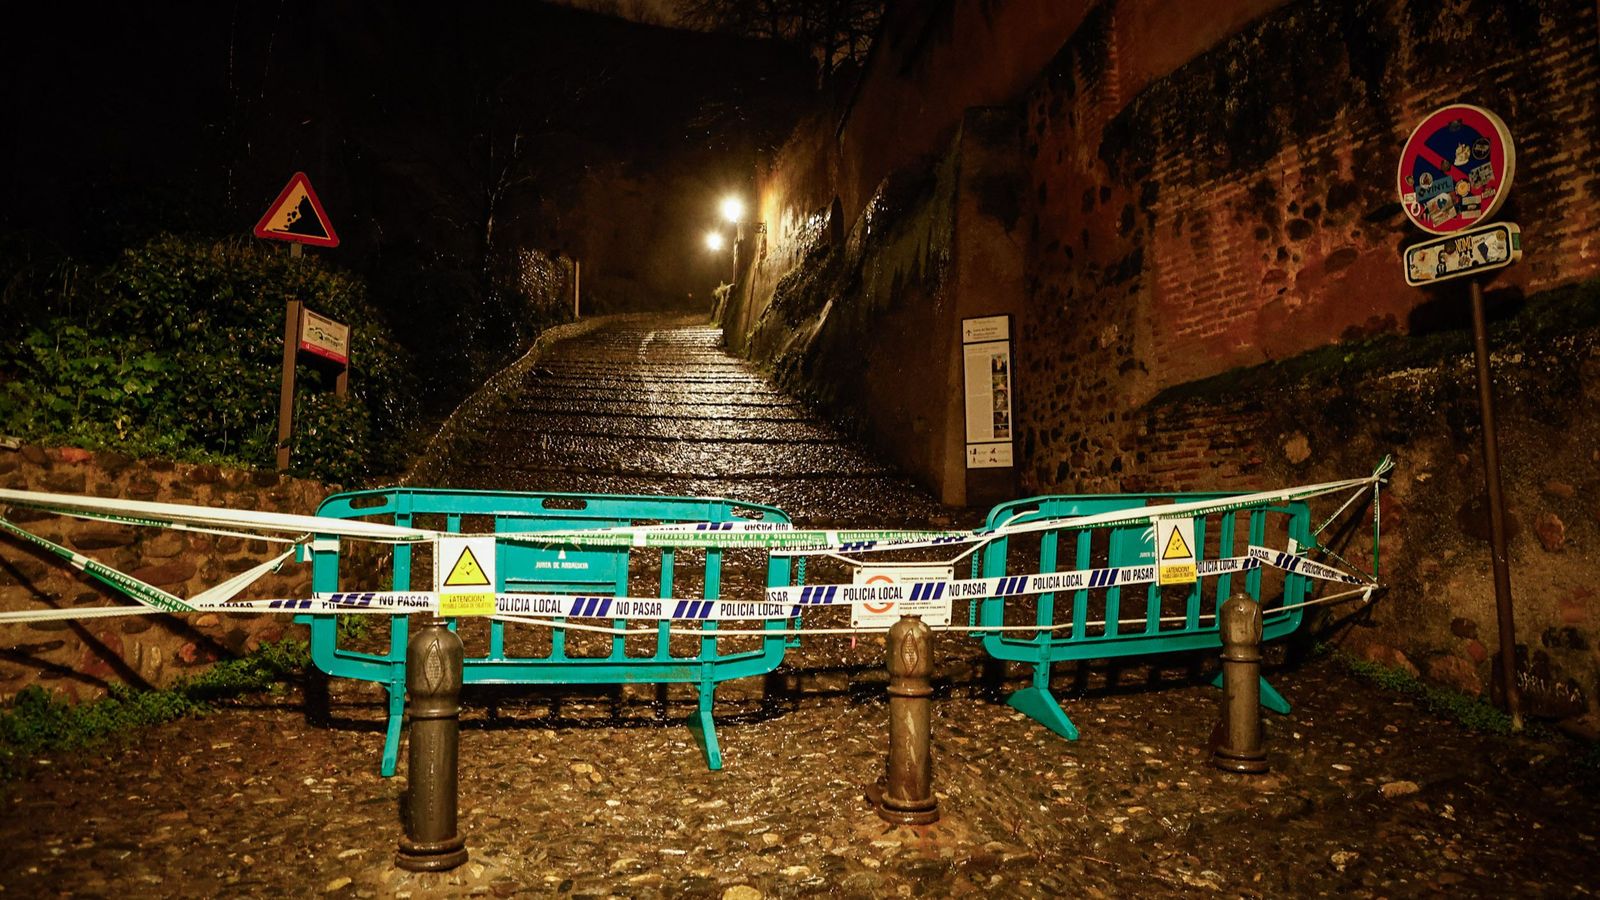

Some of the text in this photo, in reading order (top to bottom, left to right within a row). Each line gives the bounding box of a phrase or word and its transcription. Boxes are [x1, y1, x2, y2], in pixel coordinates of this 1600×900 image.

[1033, 574, 1083, 590] POLICIA LOCAL
[1121, 570, 1131, 582] NO
[1133, 567, 1154, 580] PASAR
[767, 591, 788, 602] ASAR
[843, 586, 903, 601] POLICIA LOCAL
[949, 582, 986, 597] NO PASAR
[379, 596, 429, 608] NO PASAR
[533, 598, 562, 613] LOCAL
[616, 601, 662, 616] NO PASAR
[720, 603, 784, 616] POLICIA LOCAL
